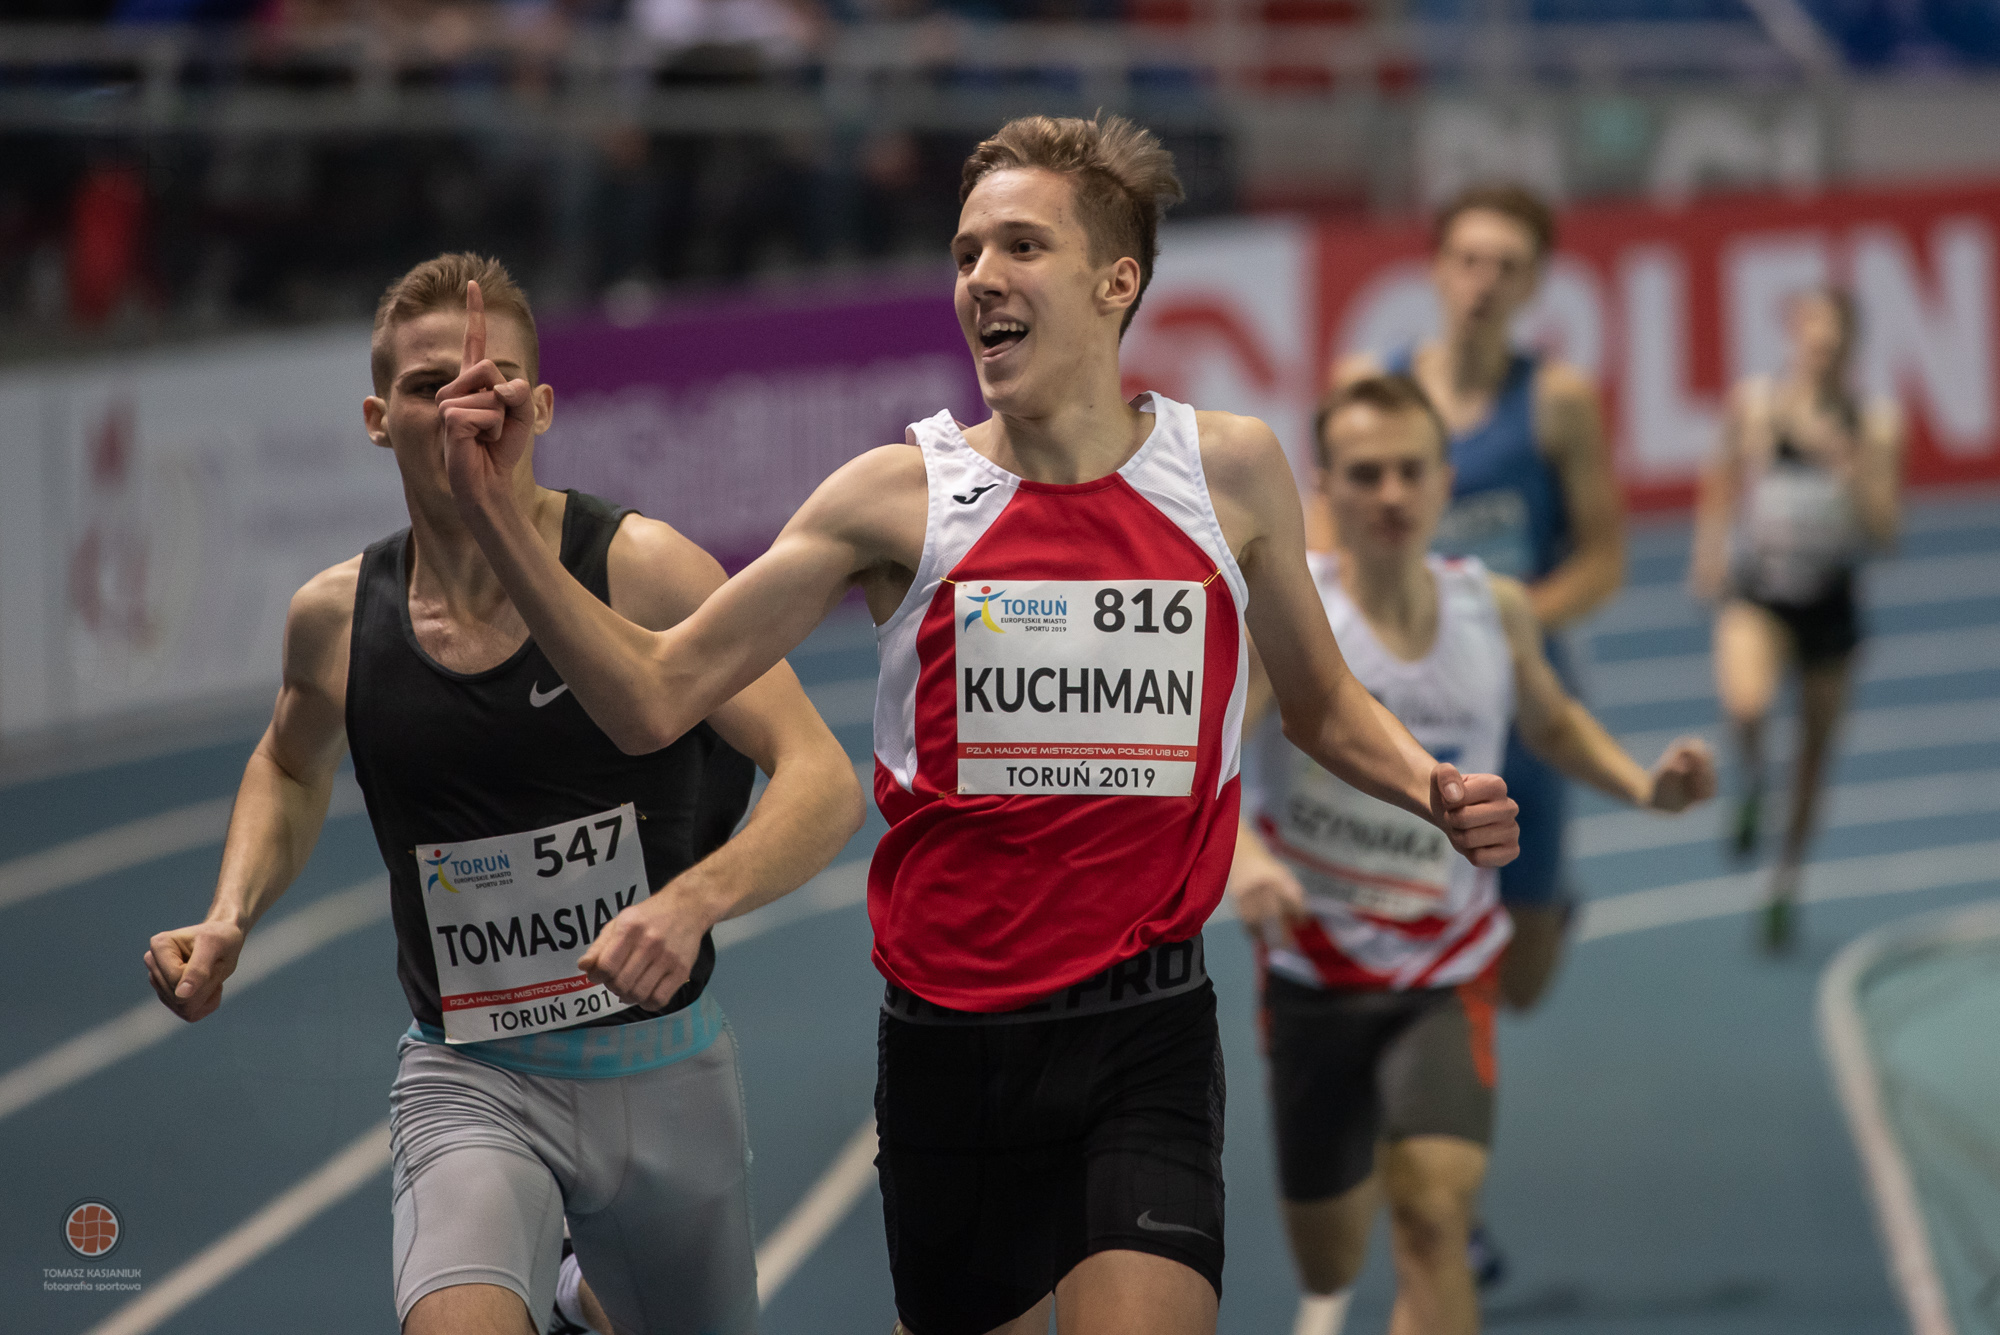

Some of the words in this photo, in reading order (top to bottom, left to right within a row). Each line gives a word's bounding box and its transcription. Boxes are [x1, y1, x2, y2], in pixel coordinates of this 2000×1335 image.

[1000, 595, 1067, 615] TORUŃ
[1093, 587, 1193, 634] 816
[1000, 617, 1041, 625] EUROPEJSKIE
[964, 667, 1194, 716] KUCHMAN
[966, 746, 993, 755] PZLA
[994, 746, 1037, 755] HALOWE
[1039, 746, 1116, 756] MISTRZOSTWA
[1117, 747, 1154, 757] POLSKI
[1155, 748, 1172, 757] U18
[1172, 749, 1190, 758] U20
[1006, 760, 1090, 788] TORUŃ
[1099, 766, 1156, 789] 2019
[533, 814, 623, 878] 547
[450, 849, 510, 876] TORUŃ
[490, 871, 512, 879] MIASTO
[475, 880, 498, 889] SPORTU
[499, 878, 514, 886] 2019
[449, 998, 475, 1007] PZLA
[475, 992, 513, 1004] HALOWE
[513, 979, 584, 999] MISTRZOSTWA
[489, 996, 567, 1032] TORUŃ
[573, 989, 623, 1018] 201
